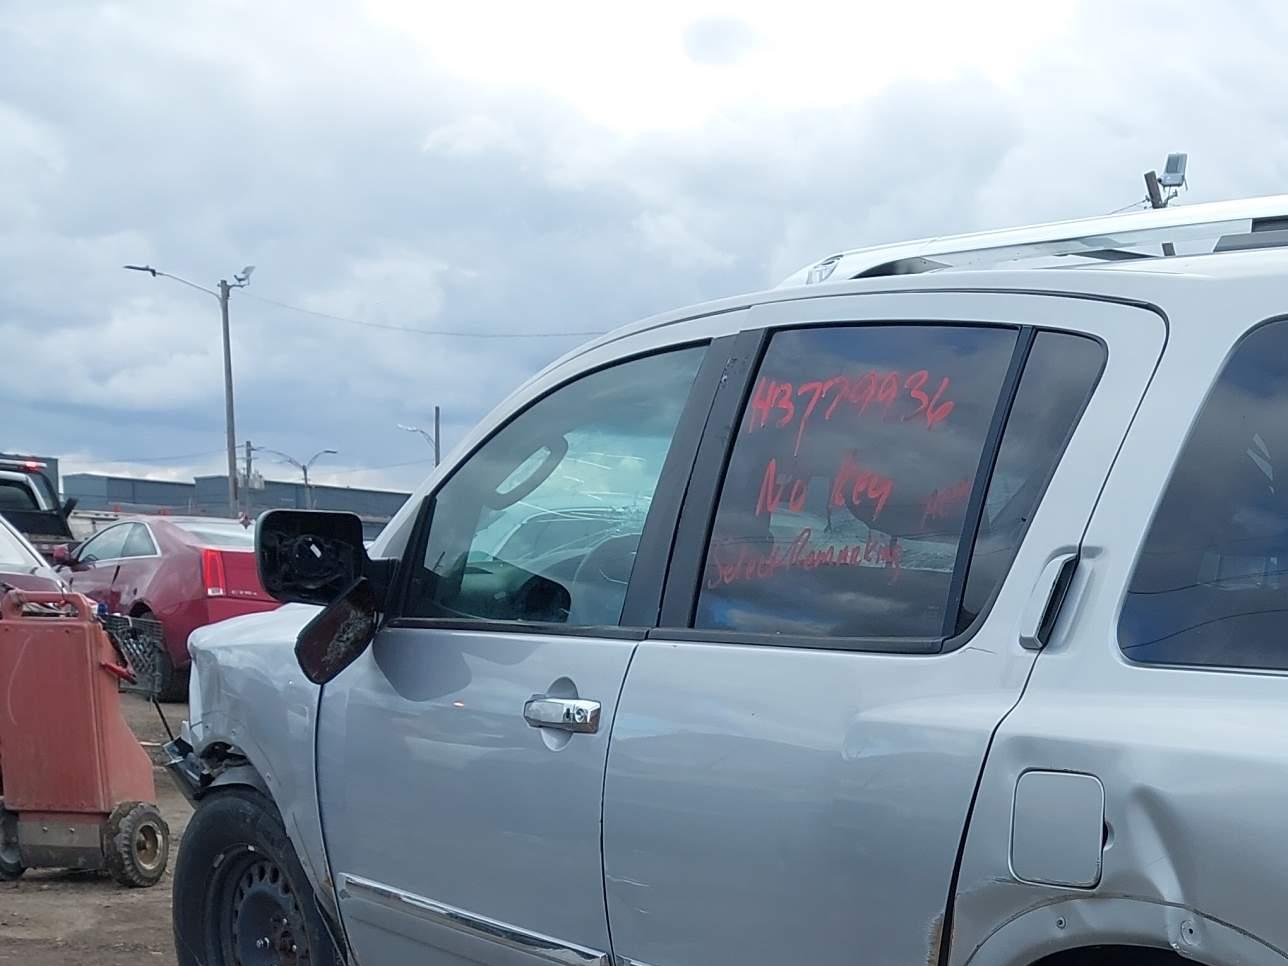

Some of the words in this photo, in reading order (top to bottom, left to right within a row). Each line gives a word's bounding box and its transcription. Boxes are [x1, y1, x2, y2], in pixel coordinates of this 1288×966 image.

[750, 368, 955, 457] 43779936
[756, 458, 805, 516] No
[829, 450, 894, 521] Key
